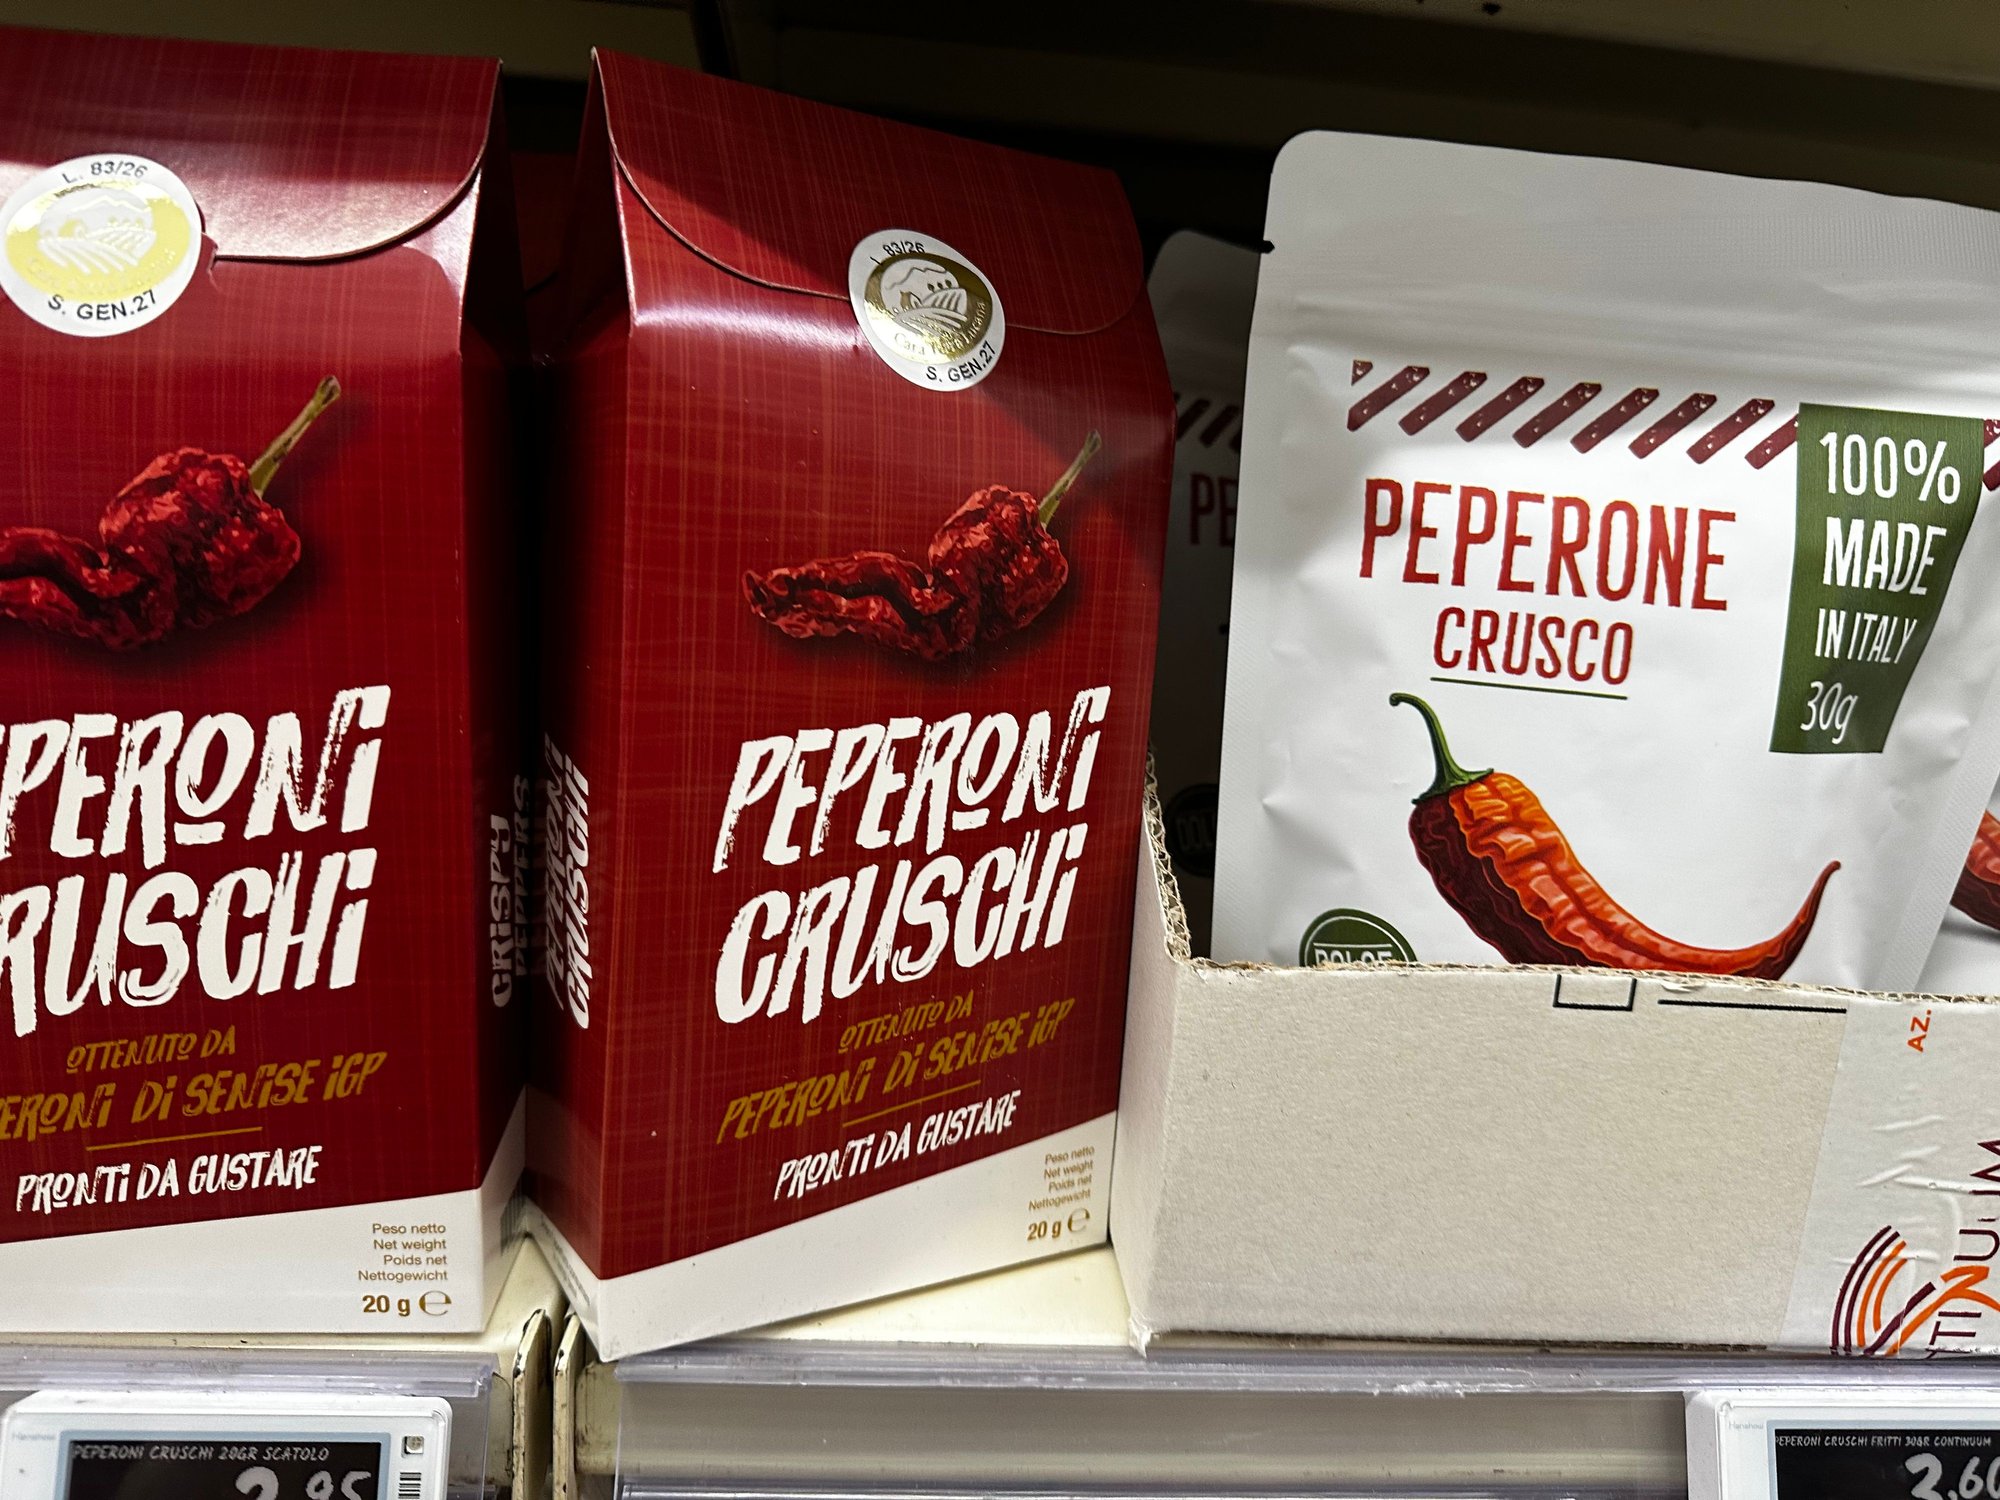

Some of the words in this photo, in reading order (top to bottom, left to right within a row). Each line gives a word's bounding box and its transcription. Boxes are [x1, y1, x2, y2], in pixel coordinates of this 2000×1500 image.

[90, 160, 149, 179] 83/26
[882, 240, 926, 256] 83/26
[48, 294, 67, 316] S.
[76, 289, 157, 321] GEN.27
[925, 365, 943, 383] S.
[947, 340, 996, 383] GEN.27
[1819, 431, 1961, 505] 100%
[1359, 478, 1736, 611] PEPERONE
[1822, 516, 1948, 596] MADE
[1433, 606, 1633, 686] CRUSCO
[1814, 607, 1847, 660] IN
[1847, 611, 1918, 665] ITALY
[1800, 680, 1859, 746] 30g
[838, 1000, 945, 1055] OTTENUTO
[945, 989, 974, 1024] DA
[1906, 1009, 1932, 1053] AZ.
[66, 1032, 198, 1075] OTTENUTO
[200, 1024, 236, 1059] DA
[874, 1121, 912, 1170] DA
[916, 1089, 1022, 1155] GUSTARE
[1043, 1166, 1061, 1181] Net
[1063, 1159, 1094, 1176] weight
[1045, 1152, 1069, 1166] Peso
[1071, 1145, 1095, 1160] netto
[136, 1157, 180, 1201] DA
[187, 1145, 323, 1196] GUSTARE
[372, 1222, 407, 1234] Peso
[411, 1223, 446, 1234] netto
[1026, 1220, 1048, 1241] 20
[1051, 1220, 1062, 1240] g
[373, 1239, 398, 1250] Net
[401, 1239, 447, 1253] weight
[383, 1254, 422, 1266] Poids
[426, 1254, 448, 1266] net
[358, 1270, 448, 1283] Nettogewicht
[362, 1294, 391, 1313] 20
[397, 1298, 411, 1317] g
[72, 1445, 145, 1460] PEPERONI
[148, 1445, 215, 1460] CRUSCHI
[217, 1446, 258, 1461] 20GR
[262, 1447, 330, 1461] SCATOLO
[1774, 1435, 1822, 1447] PEPERONI
[1823, 1435, 1868, 1447] CRUSCHI
[1870, 1435, 1902, 1447] FRITTI
[1933, 1435, 1992, 1447] CONTINUUM
